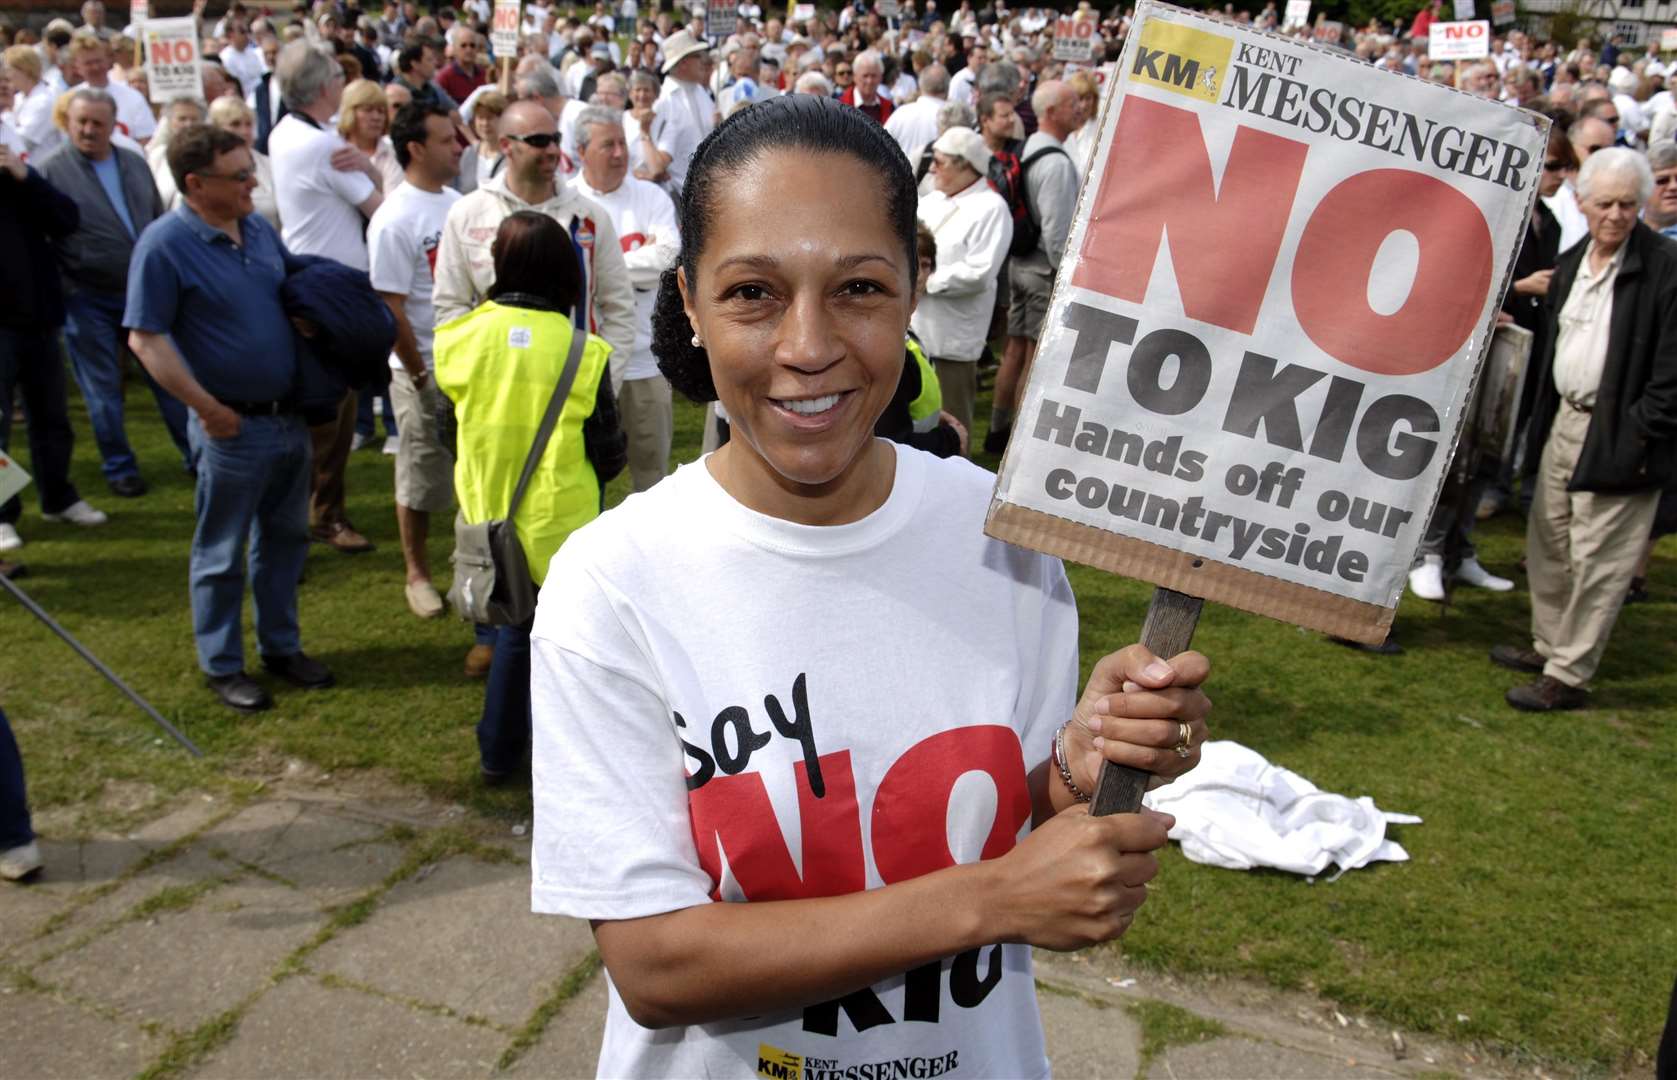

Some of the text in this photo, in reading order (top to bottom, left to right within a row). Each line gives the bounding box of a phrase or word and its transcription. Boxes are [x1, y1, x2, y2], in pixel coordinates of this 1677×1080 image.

[1055, 20, 1092, 38] NO
[1444, 24, 1483, 39] NO
[150, 40, 194, 65] NO
[1133, 46, 1199, 89] KM
[1238, 43, 1302, 77] KENT
[1222, 65, 1531, 192] MESSENGER
[1071, 94, 1494, 376] NO
[1061, 302, 1440, 480] TO KIG
[1032, 399, 1412, 539] Hands off our
[1045, 468, 1369, 583] countryside
[686, 724, 1032, 902] NO
[758, 1058, 788, 1080] KM
[803, 1050, 959, 1080] MESSENGER
[804, 1056, 838, 1070] KENT
